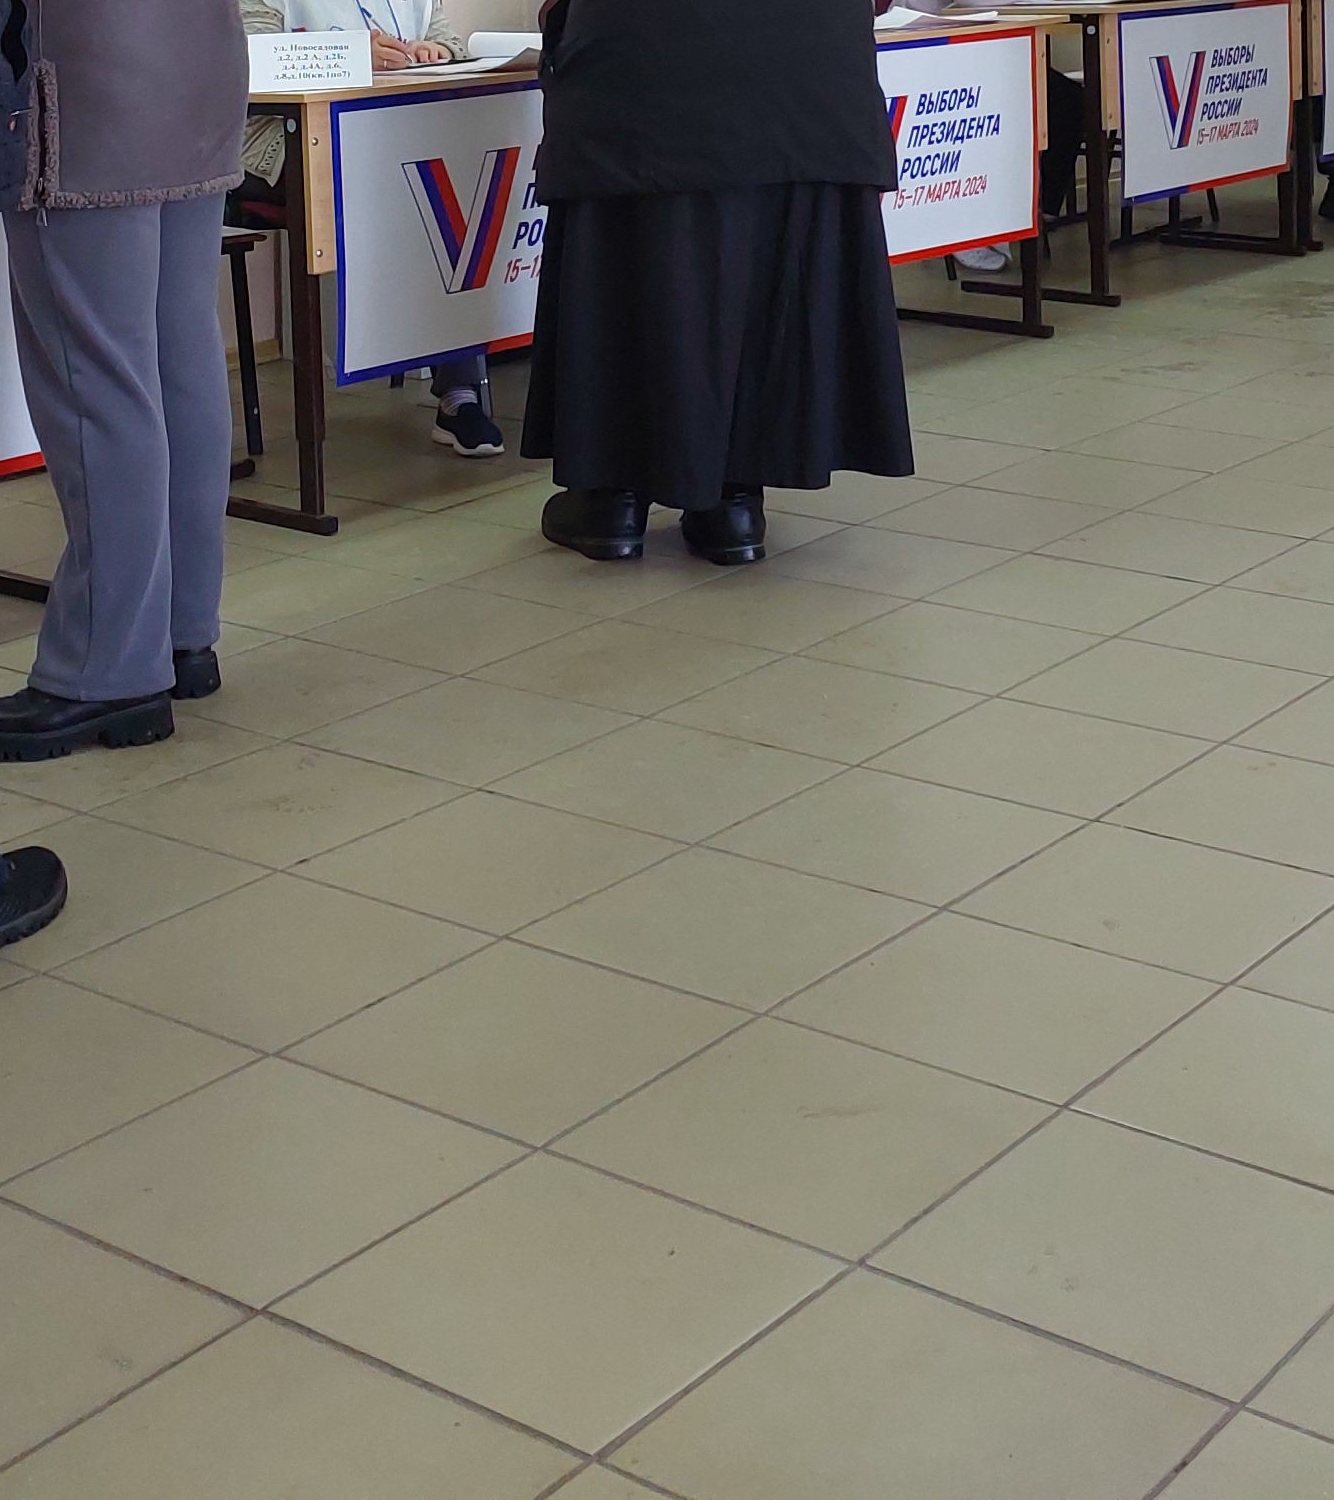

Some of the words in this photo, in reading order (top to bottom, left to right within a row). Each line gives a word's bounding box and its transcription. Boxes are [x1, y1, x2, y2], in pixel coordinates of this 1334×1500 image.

[1210, 43, 1255, 69] ВЫБОРЫ
[1205, 67, 1268, 95] ПРЕЗИДЕНТА
[915, 86, 982, 116] ВЫБОРЫ
[1199, 97, 1243, 122] РОССИИ
[906, 113, 1001, 149] ПРЕЗИДЕНТА
[1216, 121, 1242, 142] МАРТА
[1240, 118, 1259, 137] 2024
[899, 149, 962, 182] РОССИИ
[924, 179, 962, 205] МАРТА
[962, 174, 988, 198] 2024
